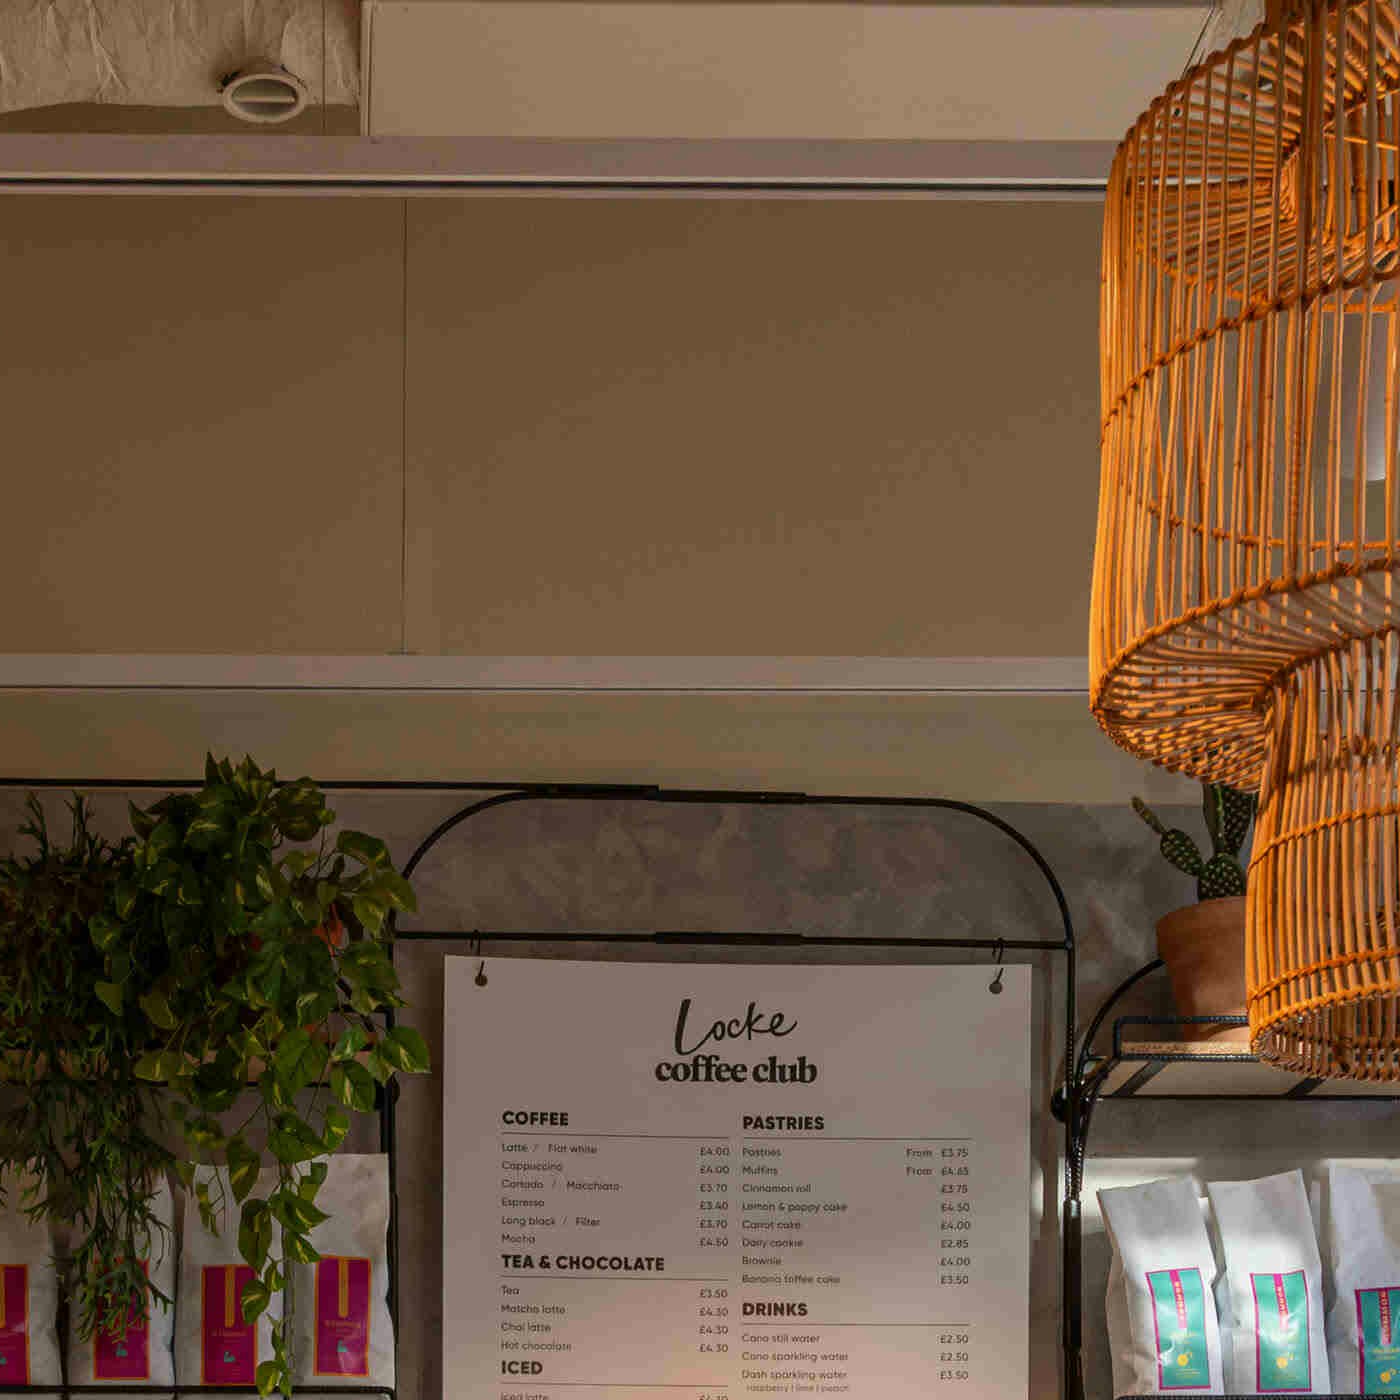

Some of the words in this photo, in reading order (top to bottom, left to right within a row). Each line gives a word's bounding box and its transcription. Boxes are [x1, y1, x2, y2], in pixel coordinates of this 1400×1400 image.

[675, 998, 797, 1055] Locke
[655, 1055, 748, 1082] coffee
[752, 1056, 817, 1083] club
[502, 1111, 569, 1126] COFFEE
[743, 1116, 825, 1130] PASTRIES
[502, 1255, 534, 1269] TEA
[539, 1255, 551, 1269] &
[556, 1256, 664, 1271] CHOCOLATE
[502, 1286, 520, 1295] Tea
[502, 1305, 539, 1314] Matcha
[542, 1305, 565, 1314] latte
[742, 1302, 808, 1317] DRINKS
[528, 1323, 551, 1332] latte
[742, 1334, 768, 1343] Cano
[791, 1335, 820, 1343] water
[821, 1353, 848, 1361] water
[502, 1360, 543, 1375] ICED
